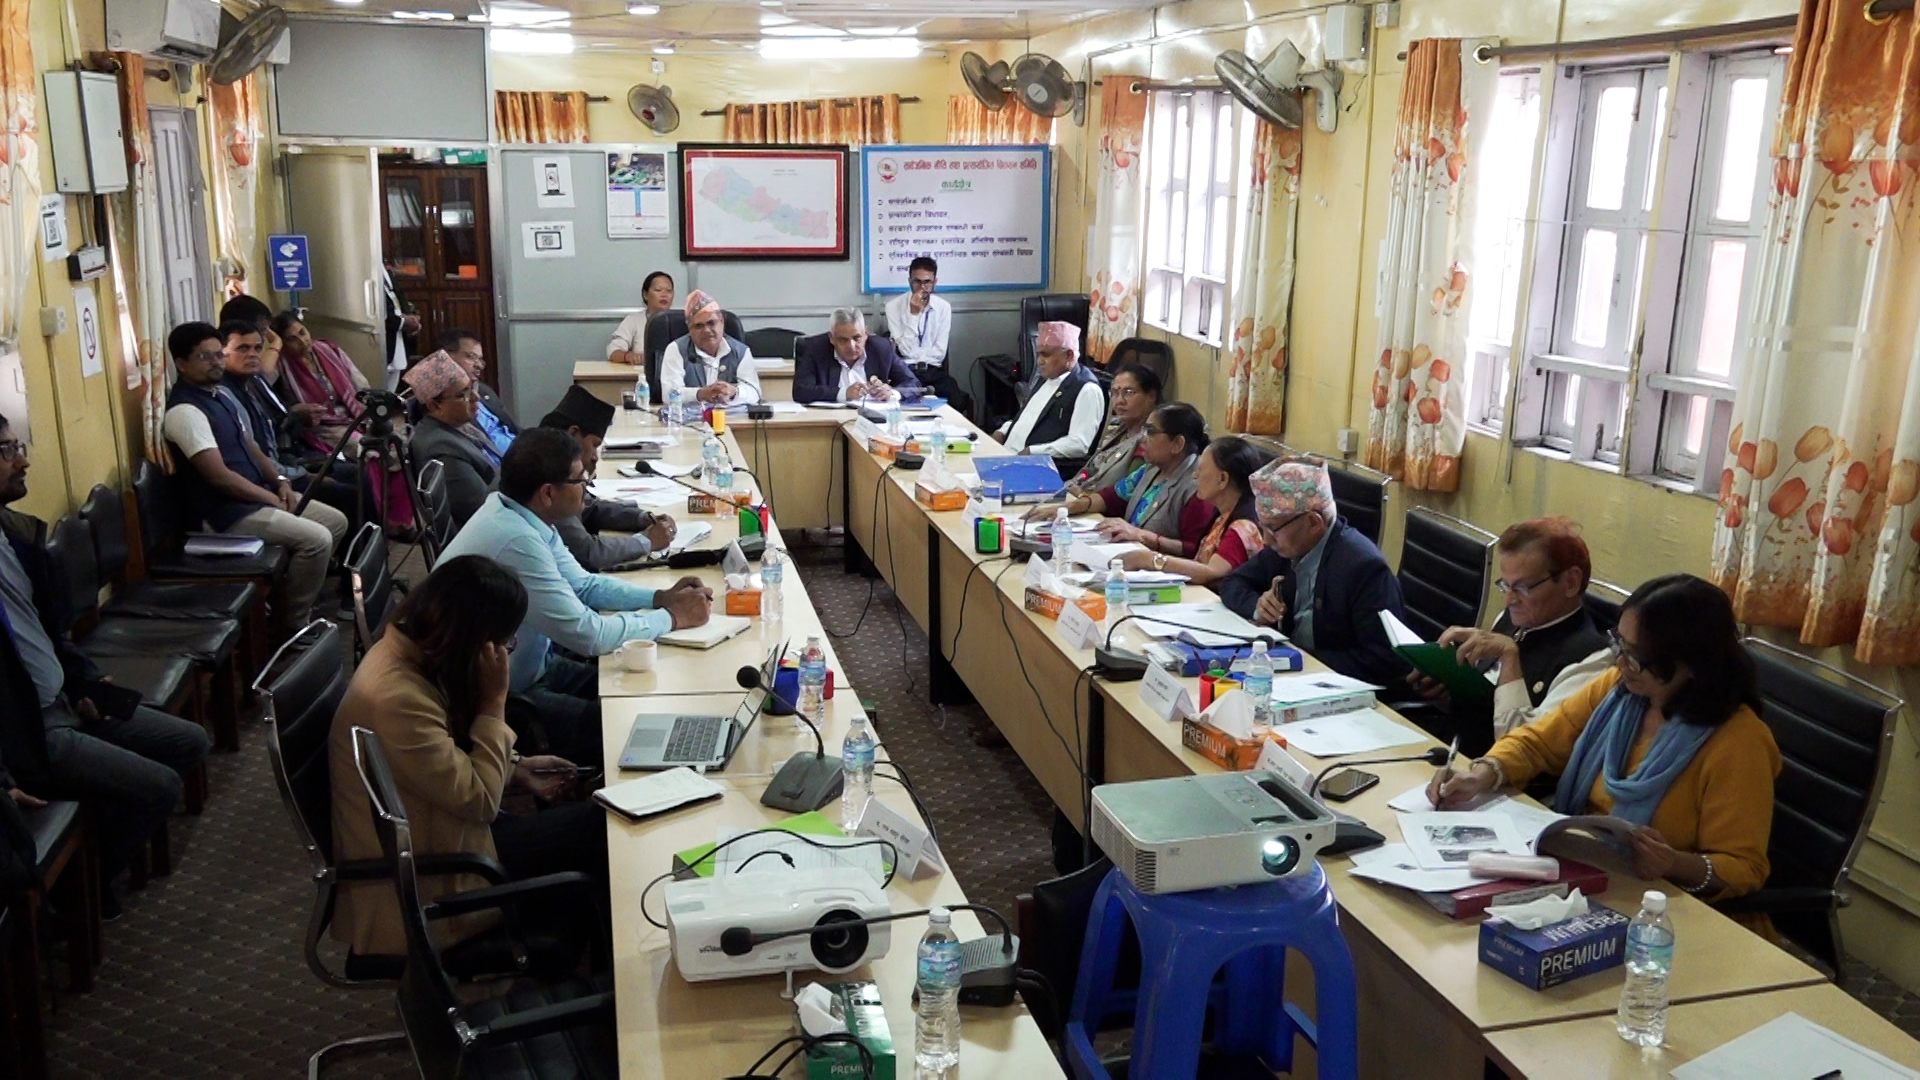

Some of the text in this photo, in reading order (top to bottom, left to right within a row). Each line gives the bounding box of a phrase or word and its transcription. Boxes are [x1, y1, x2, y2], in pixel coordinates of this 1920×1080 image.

[690, 497, 715, 509] PREM
[1184, 723, 1226, 758] PREMIUM
[1541, 938, 1616, 976] PREMIUM
[831, 1064, 875, 1074] PREMI
